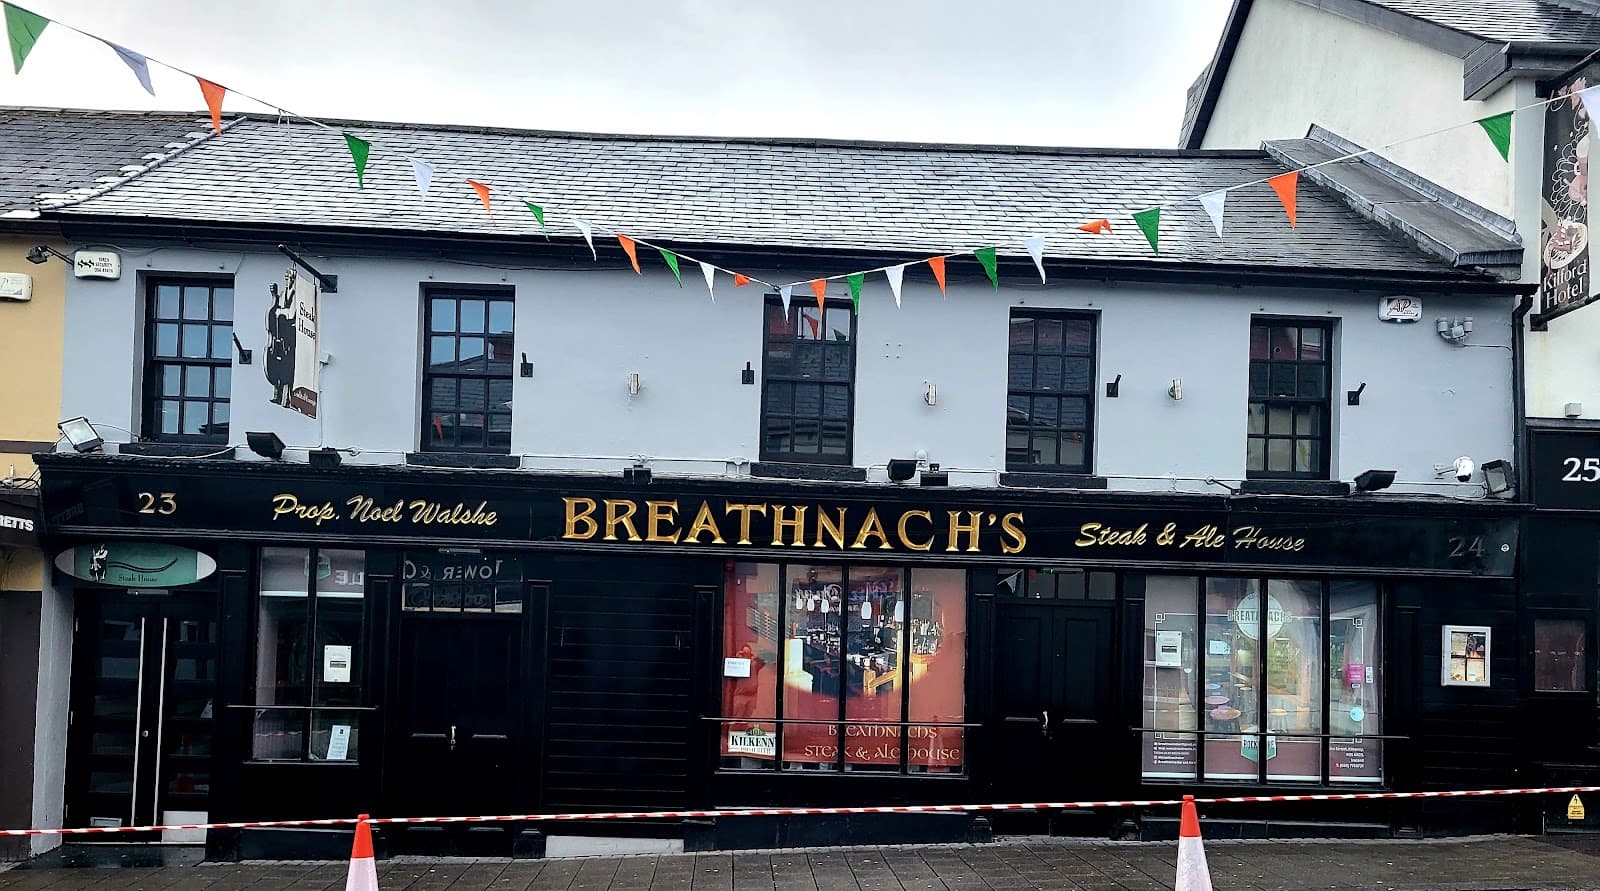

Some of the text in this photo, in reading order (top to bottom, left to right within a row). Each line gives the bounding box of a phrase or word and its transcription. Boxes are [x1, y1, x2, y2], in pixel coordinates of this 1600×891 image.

[1543, 259, 1587, 293] Kilford
[1545, 277, 1584, 309] Hotel
[299, 301, 315, 323] Steak
[298, 317, 316, 340] House
[1561, 456, 1600, 482] 25
[138, 492, 177, 515] 23
[272, 493, 498, 526] Prop. Noel Walshe
[1075, 522, 1305, 552] Steak & Ale House
[1448, 535, 1485, 558] 24
[731, 735, 777, 748] KILKENN
